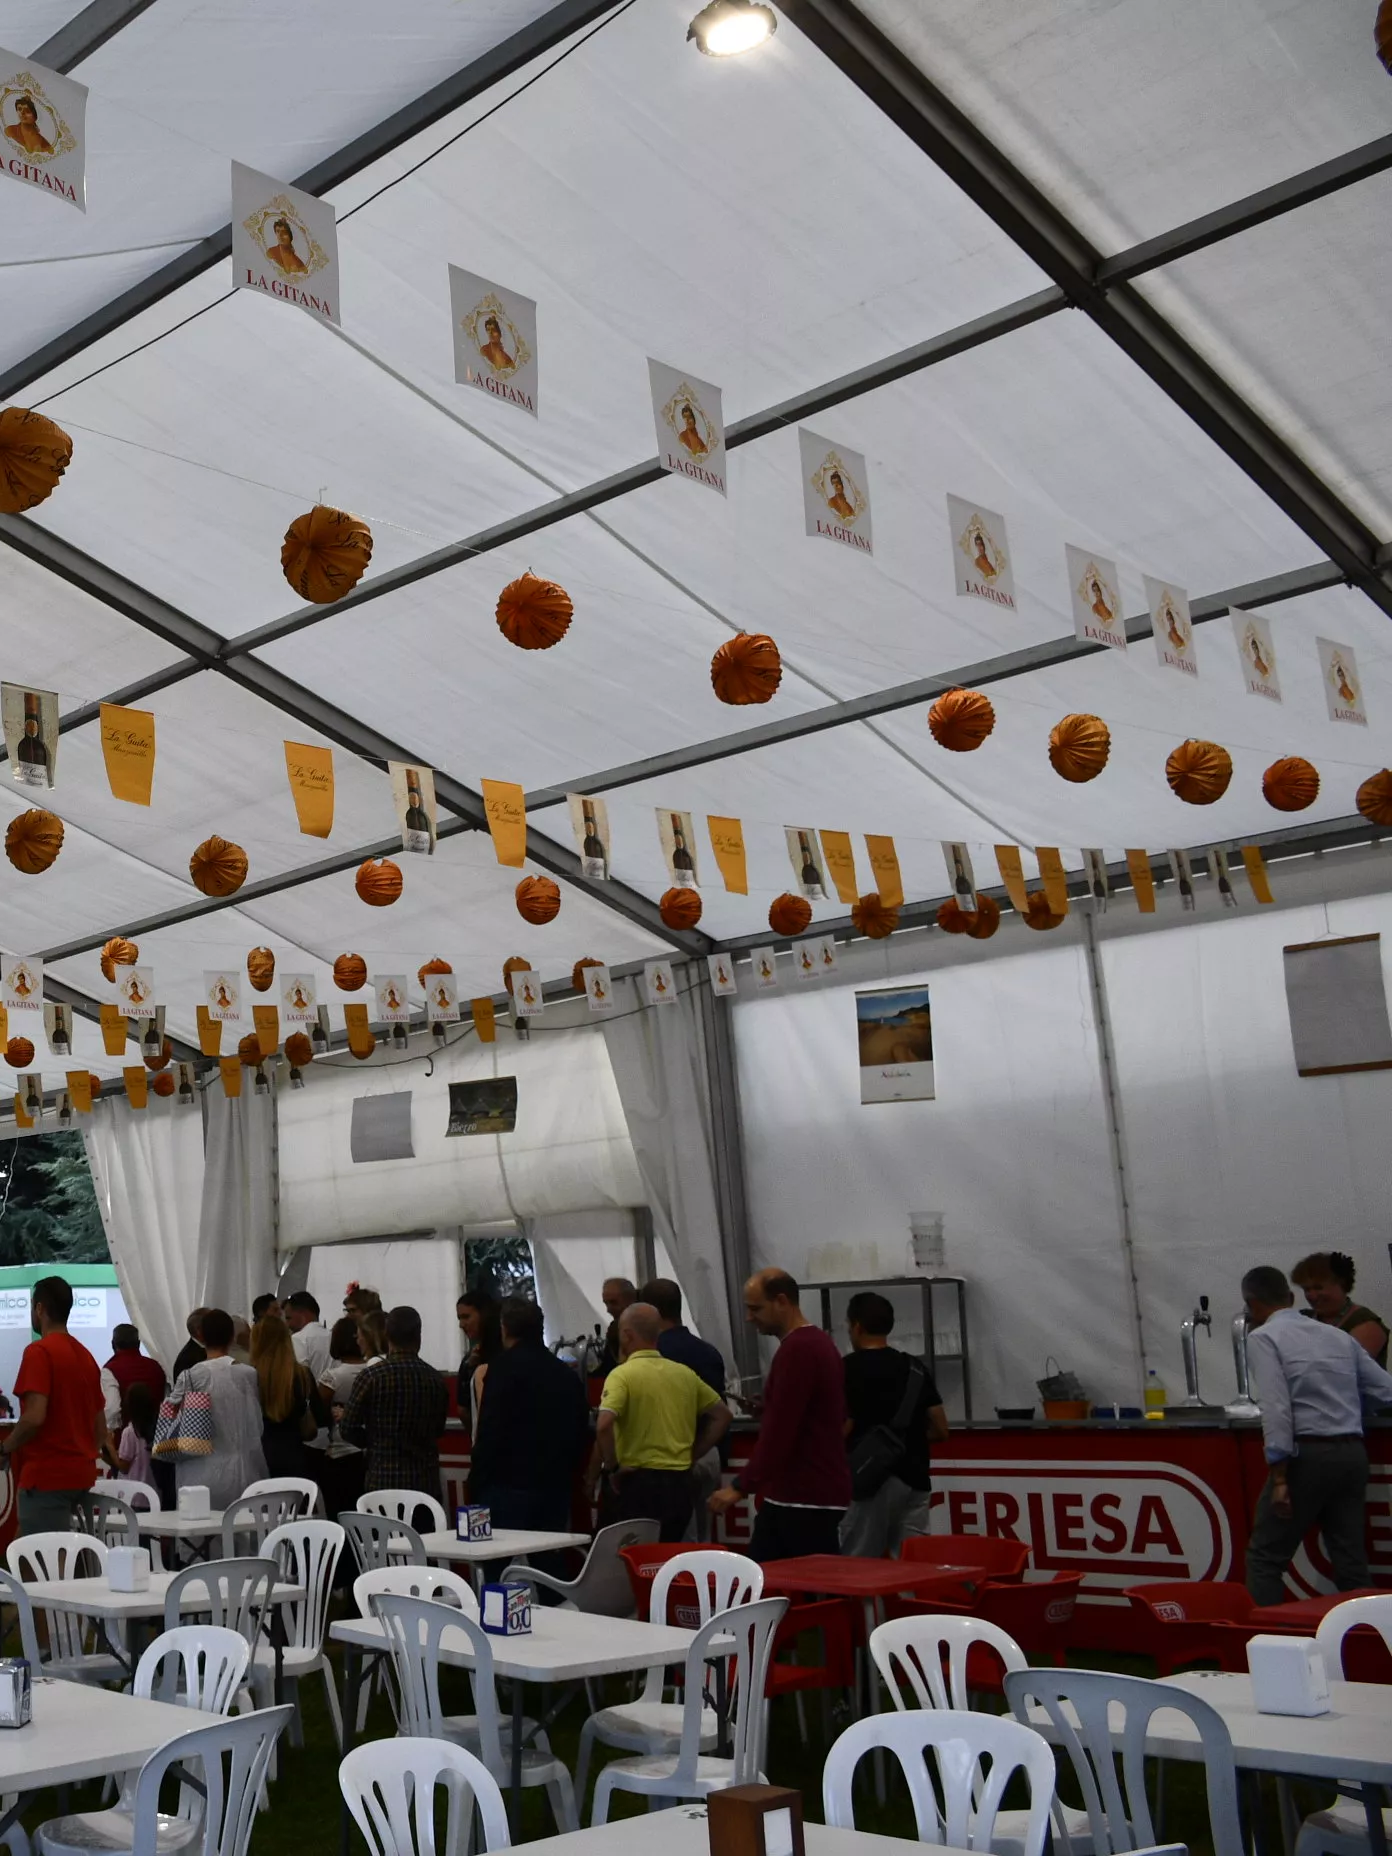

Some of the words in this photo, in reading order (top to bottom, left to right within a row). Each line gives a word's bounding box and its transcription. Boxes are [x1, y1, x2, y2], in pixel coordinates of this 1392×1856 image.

[9, 159, 78, 202] GITANA
[245, 269, 269, 291] LA
[271, 279, 332, 318] GITANA
[486, 377, 534, 412] GITANA
[667, 453, 684, 472] LA
[685, 462, 725, 492] GITANA
[816, 519, 832, 537] LA
[833, 526, 872, 552] GITANA
[964, 579, 980, 595] LA
[980, 583, 1016, 608] GITANA
[6, 1001, 16, 1009] LA
[16, 1002, 39, 1011] GITANA
[122, 1007, 132, 1016] LA
[132, 1008, 154, 1017] GITANA
[509, 1605, 532, 1631] 0,0
